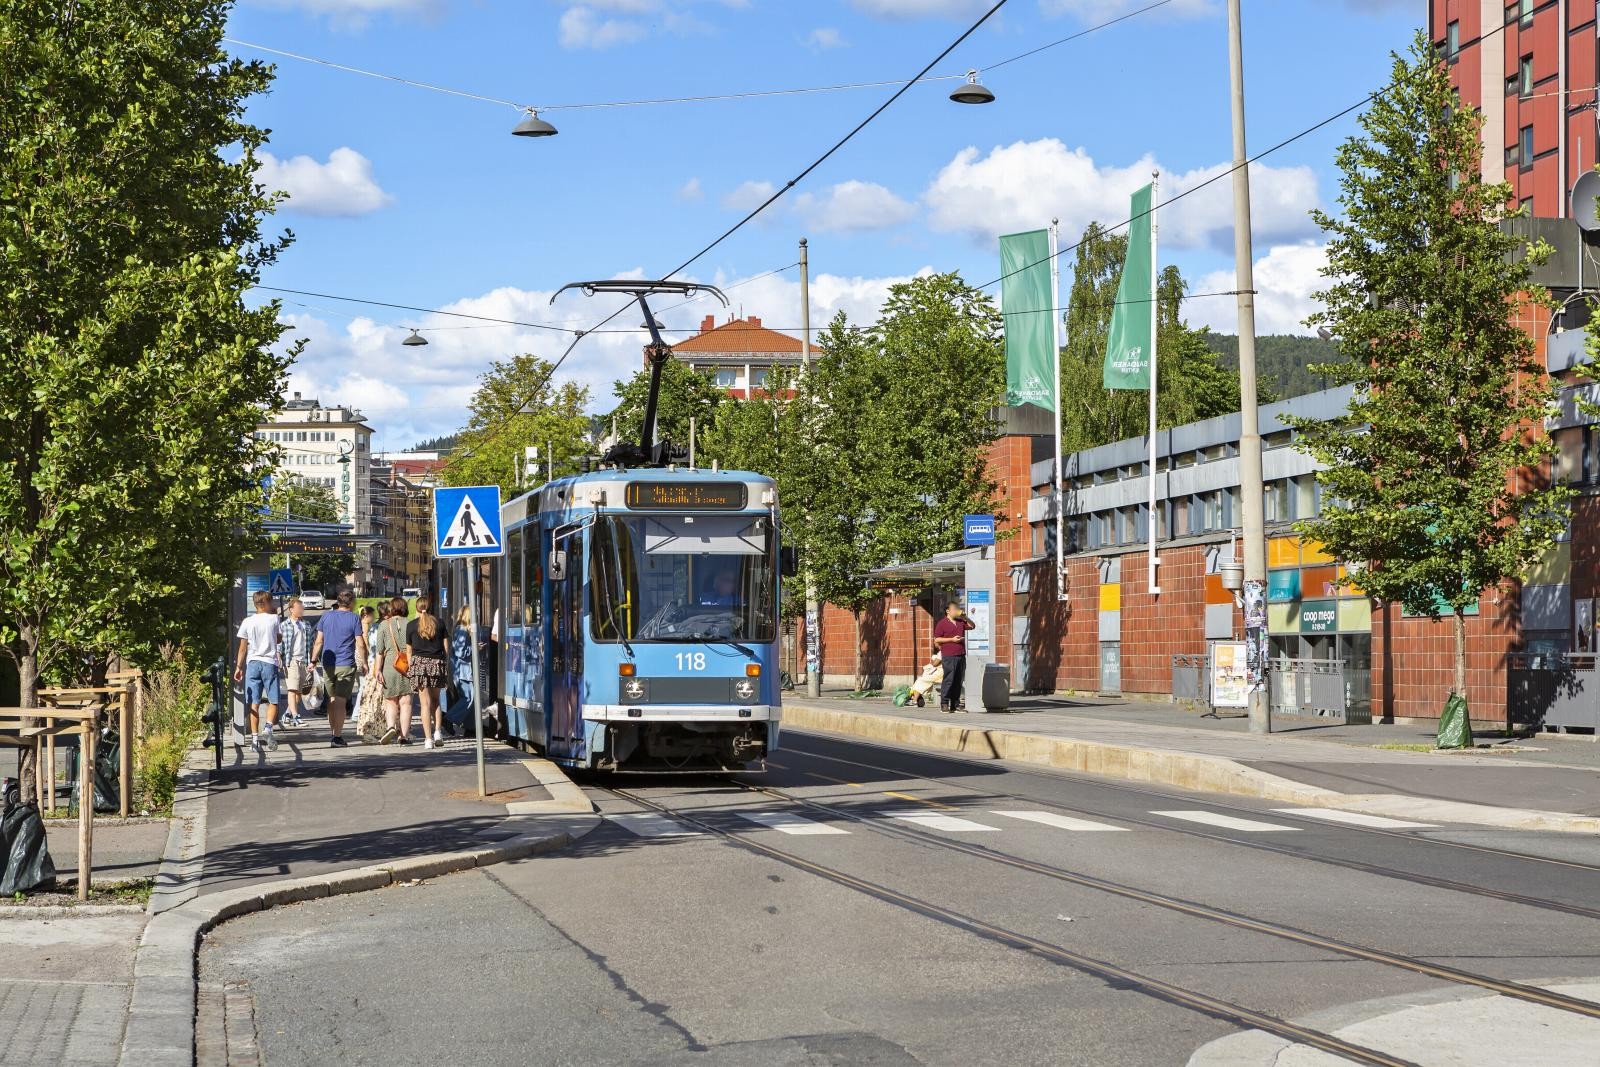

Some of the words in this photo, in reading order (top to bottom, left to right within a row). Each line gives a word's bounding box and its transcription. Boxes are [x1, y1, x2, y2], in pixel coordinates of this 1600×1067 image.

[1303, 611, 1318, 623] coop
[1318, 610, 1335, 624] mega
[675, 652, 706, 671] 118
